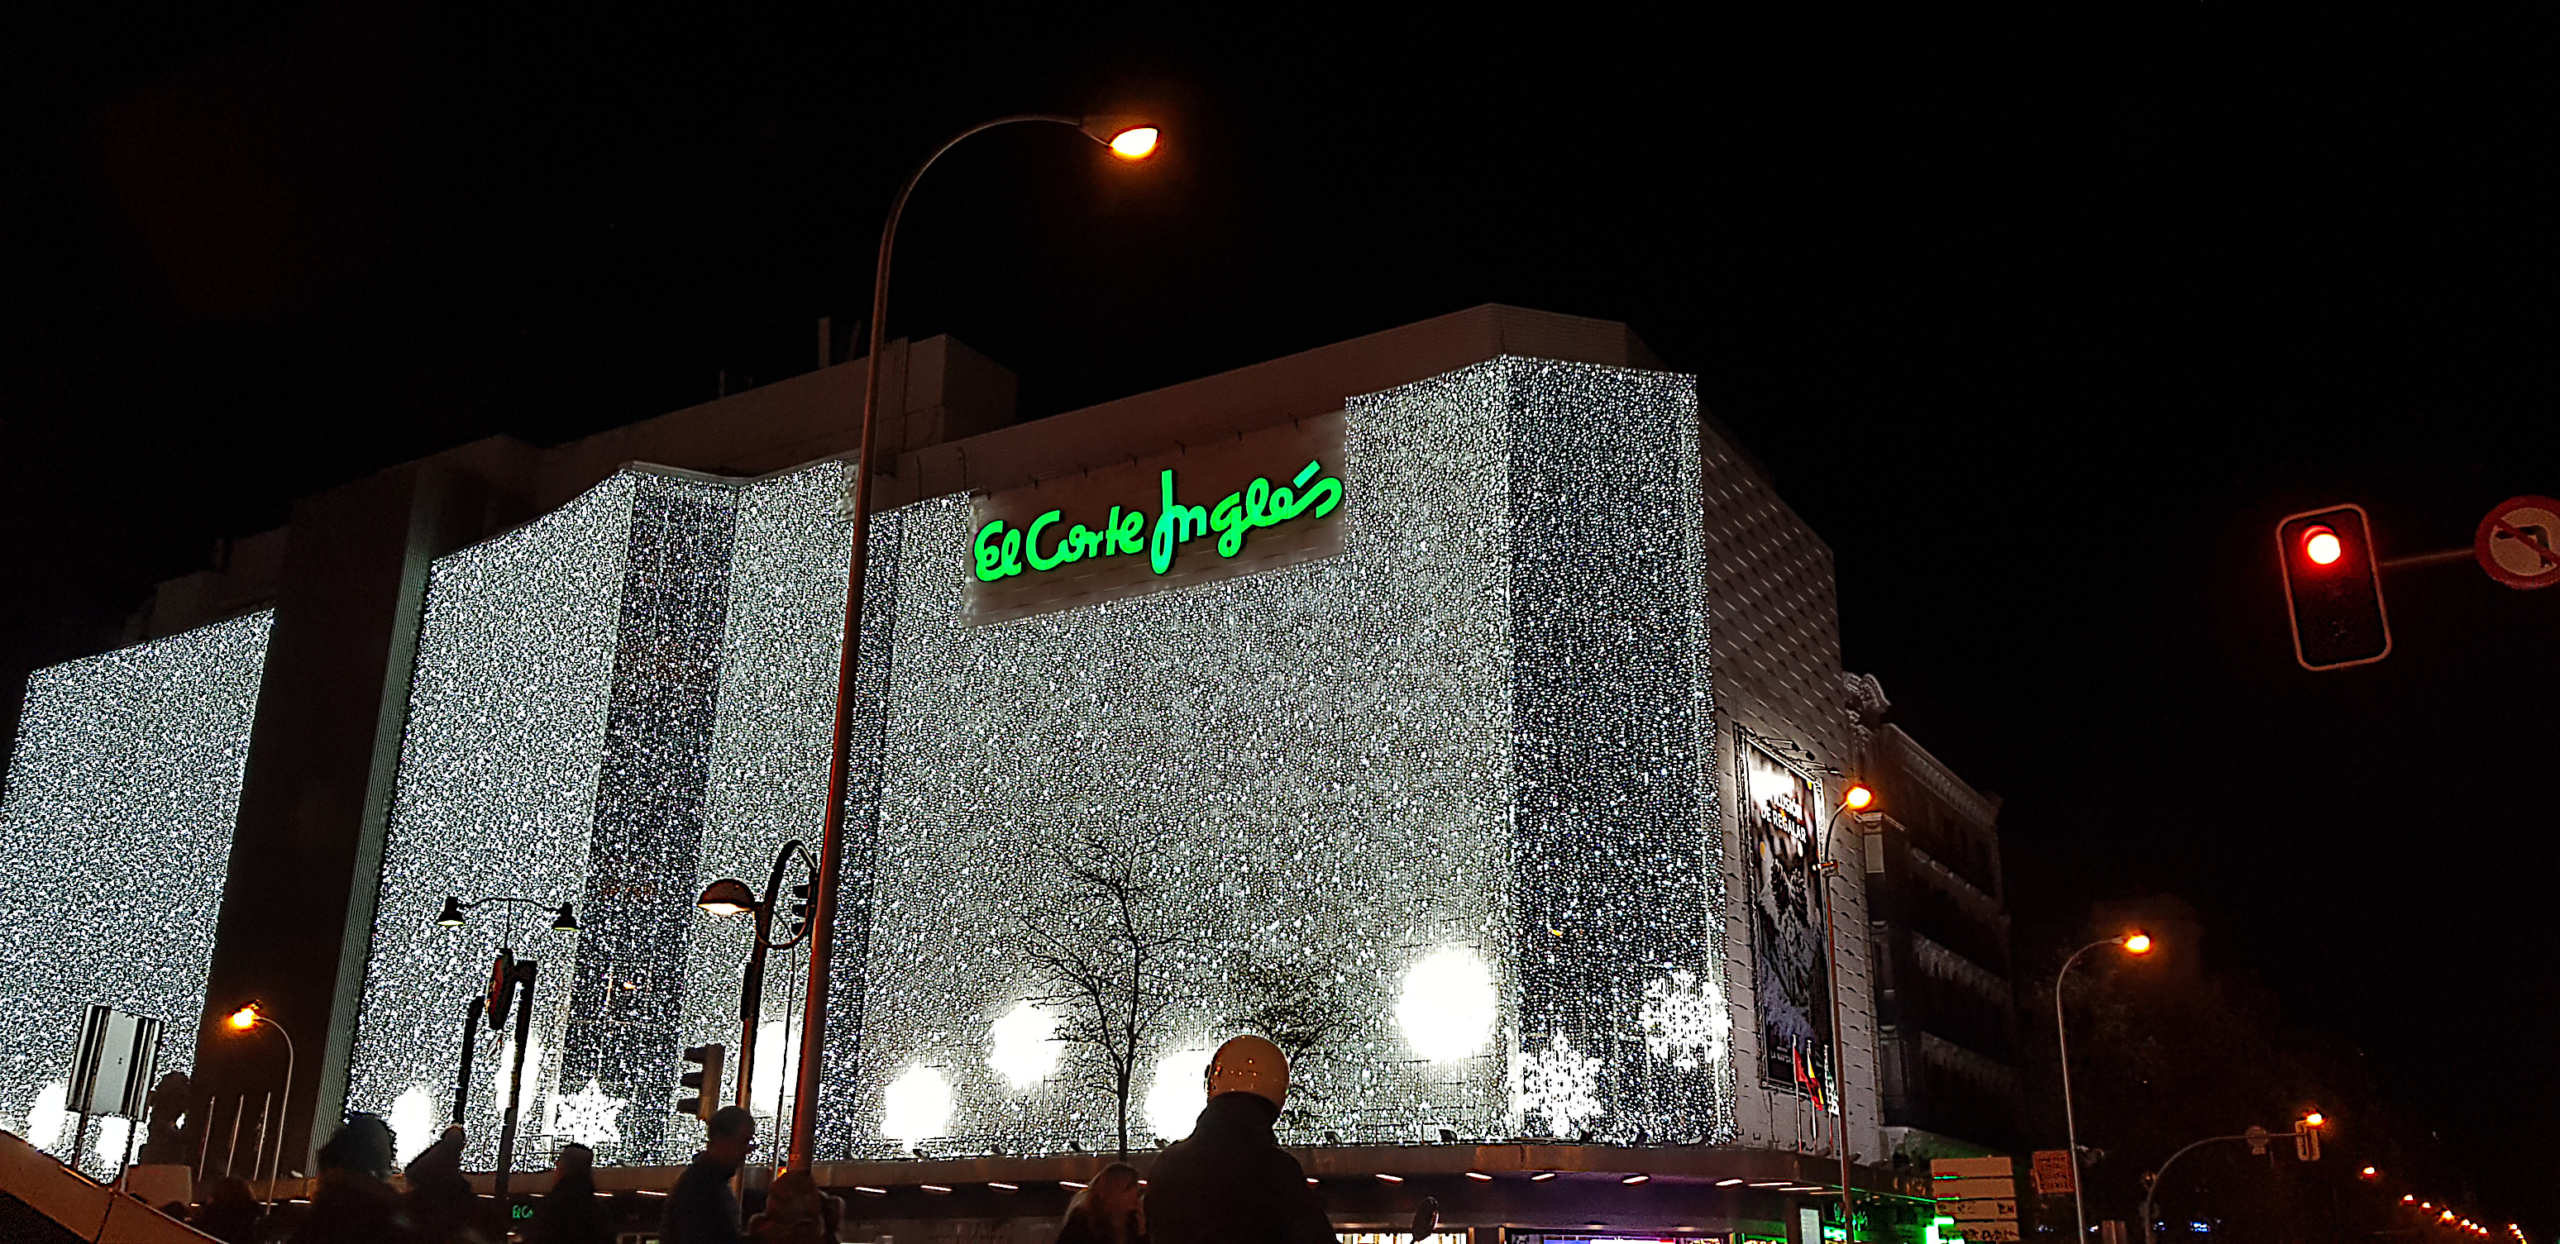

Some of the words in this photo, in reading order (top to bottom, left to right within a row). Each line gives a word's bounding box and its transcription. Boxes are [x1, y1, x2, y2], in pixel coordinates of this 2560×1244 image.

[973, 520, 1023, 582] El
[1025, 505, 1144, 572] Corte
[1150, 460, 1343, 575] Inglés
[1773, 810, 1807, 843] REGALAR
